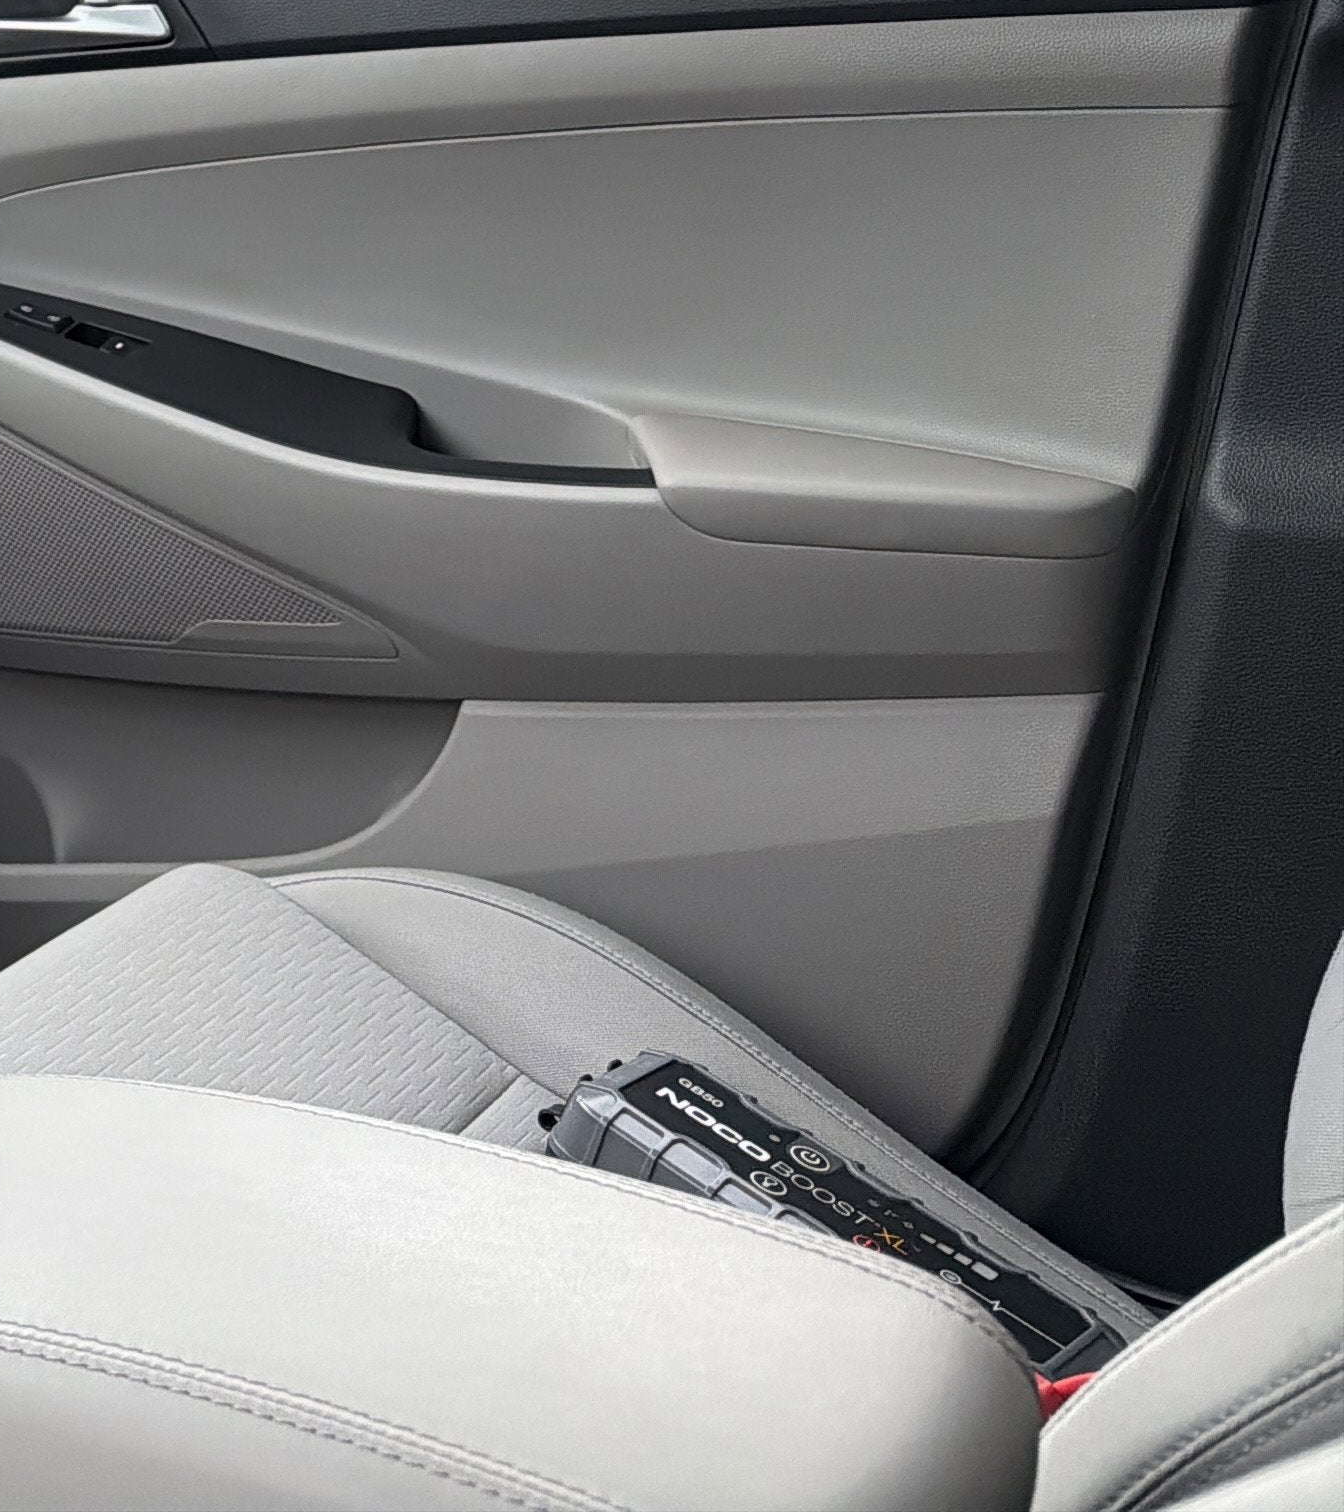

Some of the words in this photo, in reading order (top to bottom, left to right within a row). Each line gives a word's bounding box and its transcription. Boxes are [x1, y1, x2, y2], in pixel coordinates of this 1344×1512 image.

[655, 1085, 771, 1162] NOCO
[678, 1077, 724, 1109] GB50
[770, 1160, 876, 1225] BOOST
[873, 1226, 910, 1256] XL
